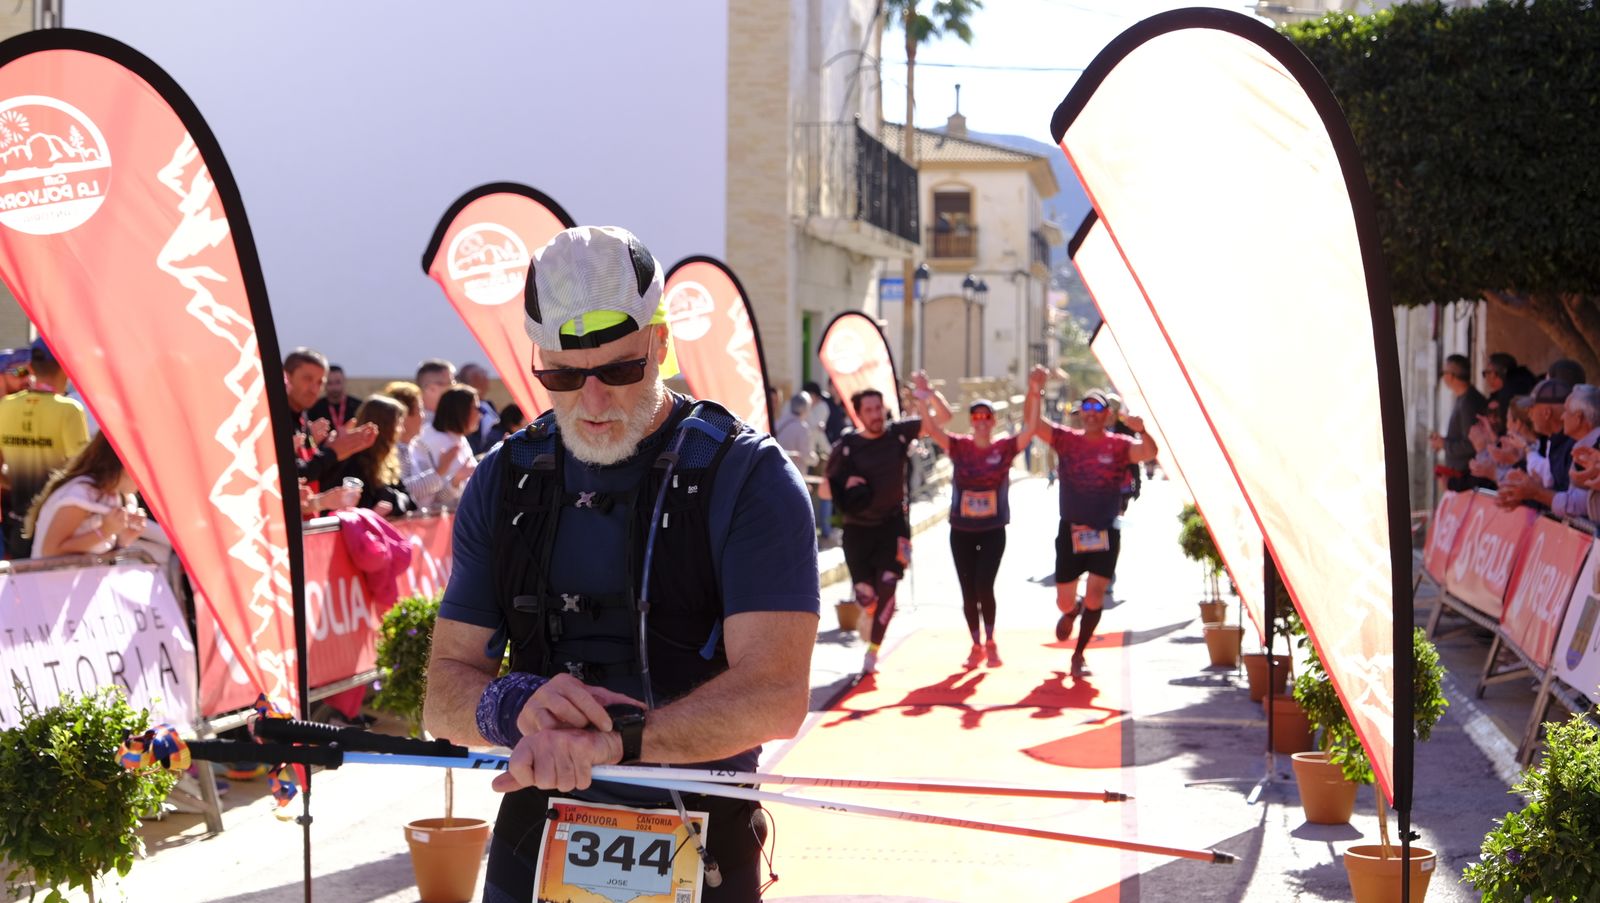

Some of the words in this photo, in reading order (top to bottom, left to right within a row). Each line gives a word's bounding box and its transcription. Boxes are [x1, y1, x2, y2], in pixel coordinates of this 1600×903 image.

[133, 607, 165, 632] DE
[304, 576, 372, 640] OLIA
[0, 642, 179, 722] NTORIA
[564, 813, 574, 823] LA
[576, 813, 618, 827] PÓLVORA
[637, 815, 672, 826] CANTORIA
[568, 831, 672, 877] 344
[606, 879, 628, 887] JOSE
